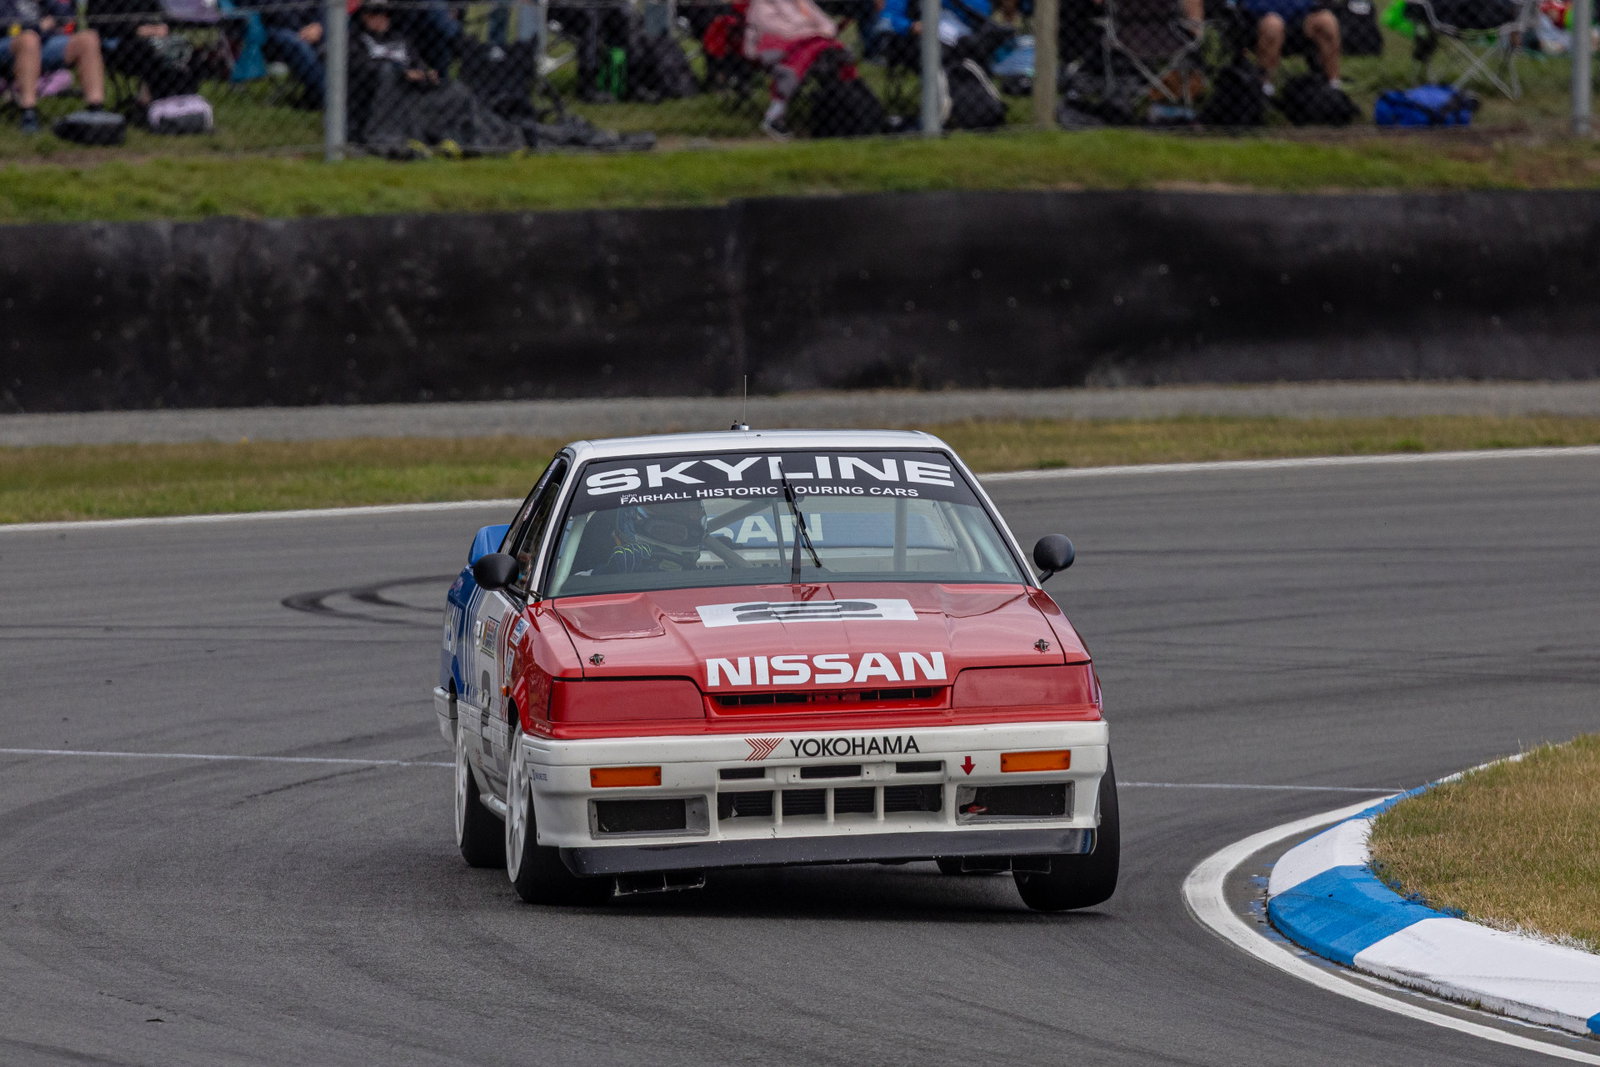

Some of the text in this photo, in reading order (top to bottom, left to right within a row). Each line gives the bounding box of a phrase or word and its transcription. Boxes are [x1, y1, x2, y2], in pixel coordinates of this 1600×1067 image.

[586, 456, 955, 496] SKYLINE
[620, 485, 919, 504] FAIRHALL HISTORIC OURING CARS
[705, 651, 947, 687] NISSAN
[790, 735, 920, 757] YOKOHAMA
